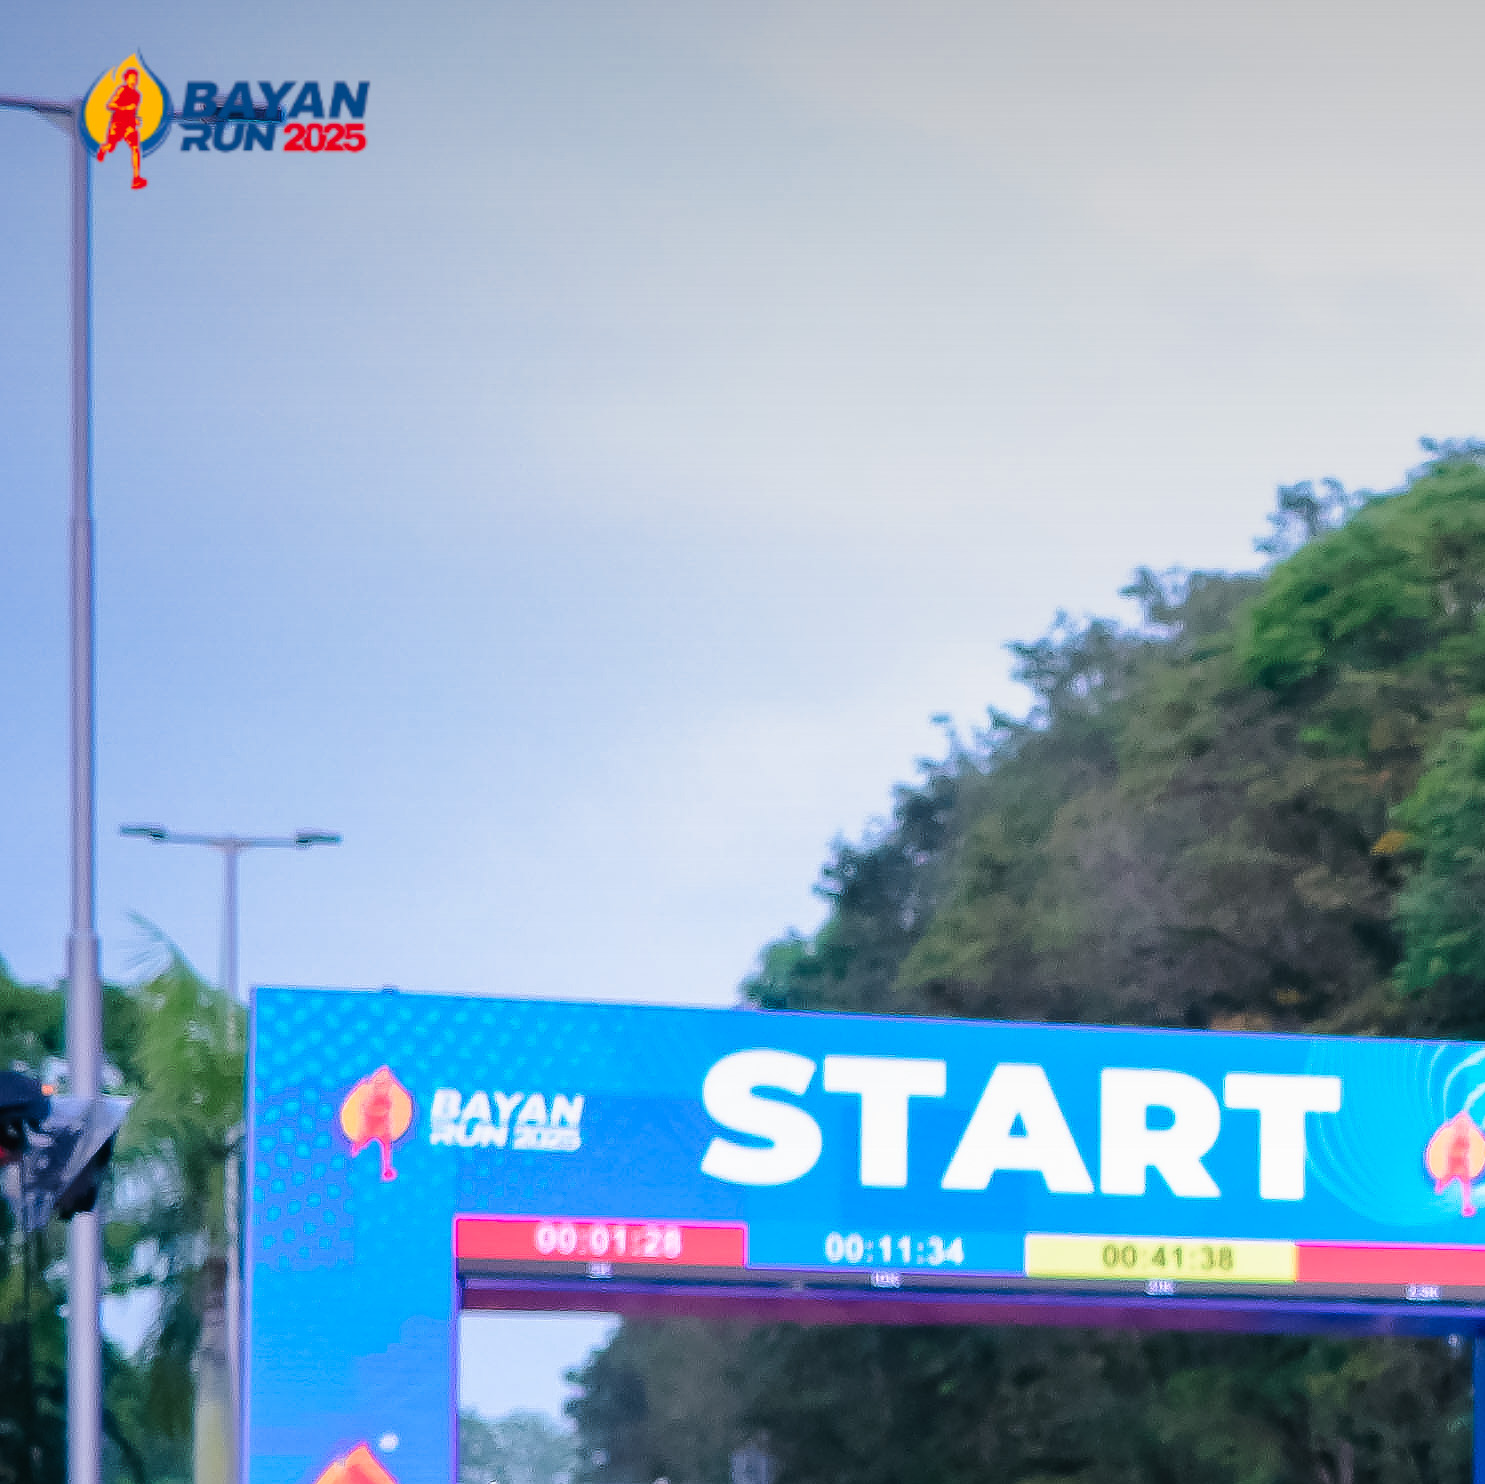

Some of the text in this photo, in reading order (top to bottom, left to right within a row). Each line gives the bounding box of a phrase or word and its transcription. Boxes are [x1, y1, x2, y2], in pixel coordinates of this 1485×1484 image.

[430, 1089, 585, 1128] BAYAN
[701, 1047, 1342, 1201] START
[430, 1121, 508, 1148] RUN
[535, 1225, 683, 1259] 00:01:28
[824, 1232, 966, 1266] 00:11:34
[1101, 1243, 1236, 1271] 00:41:38
